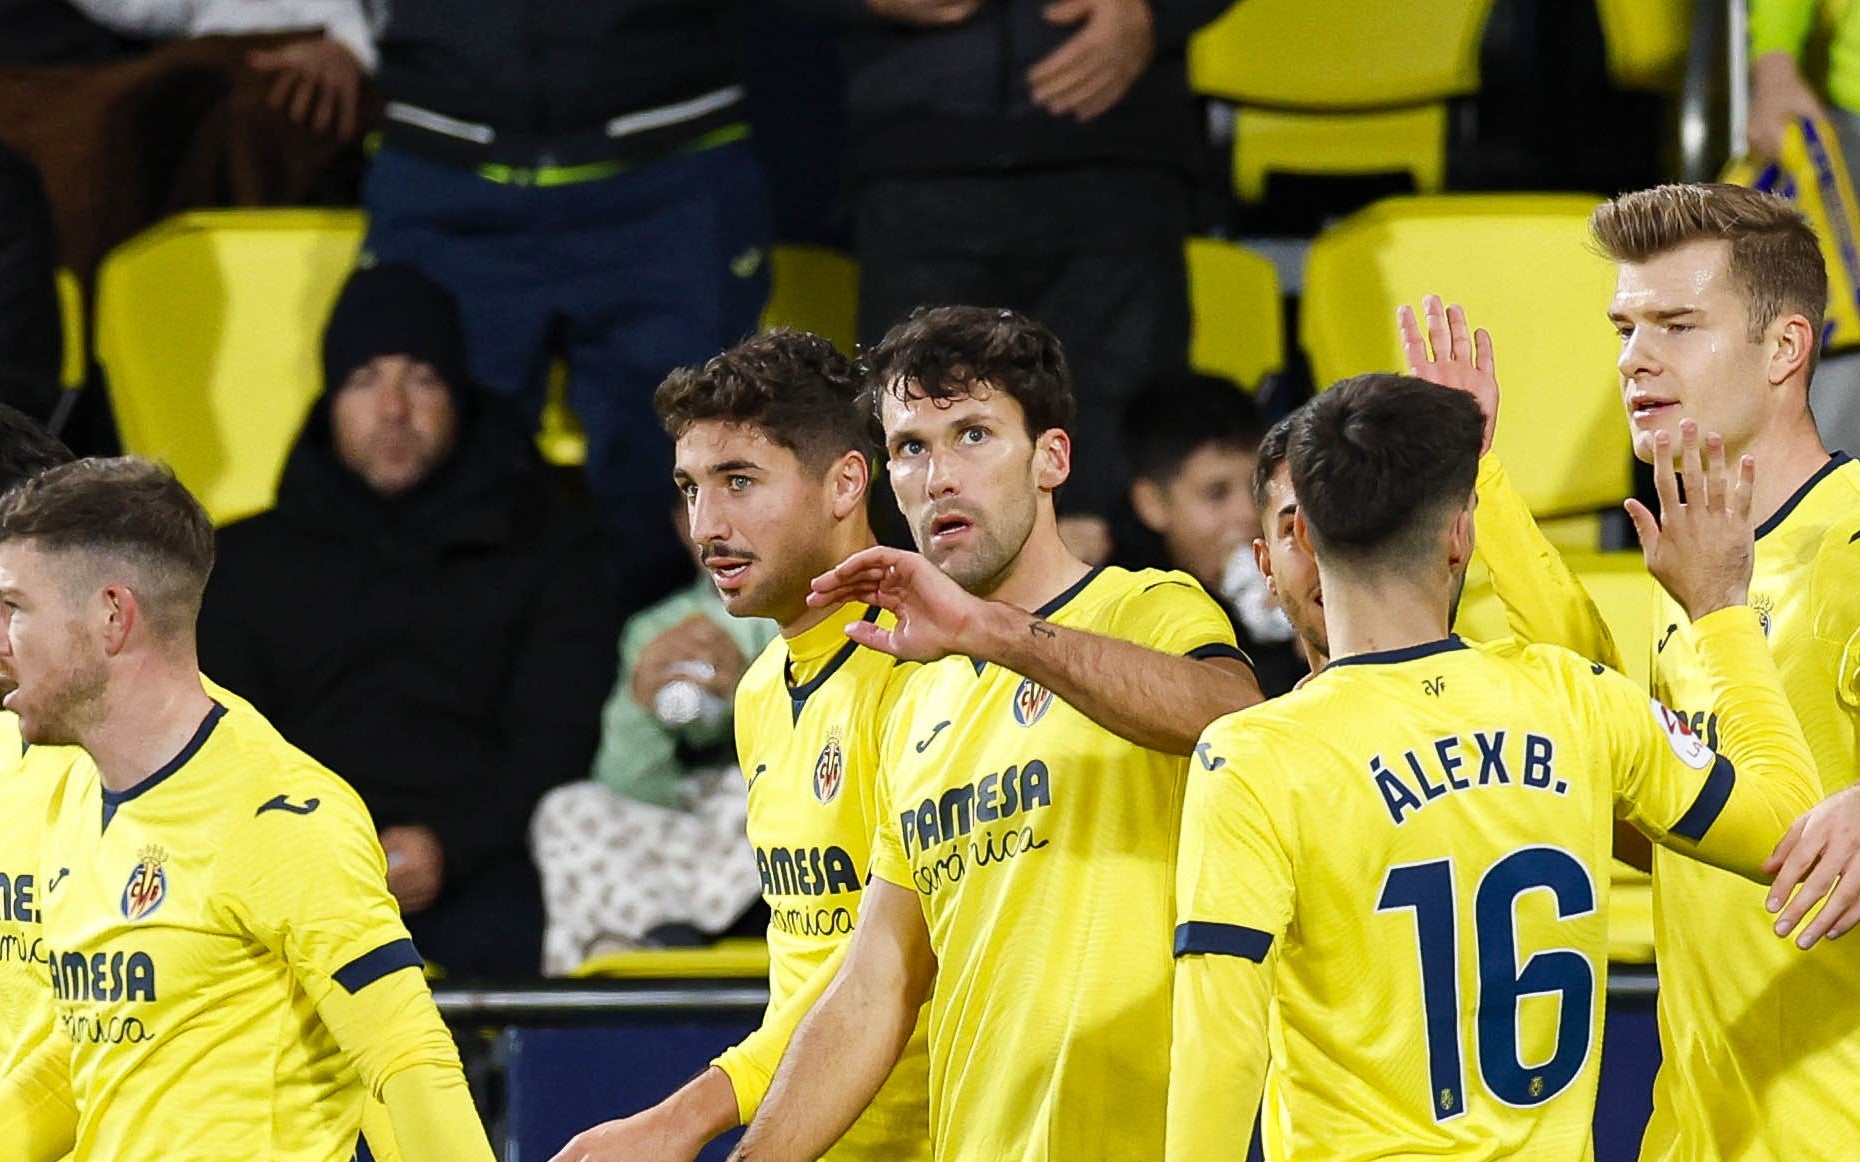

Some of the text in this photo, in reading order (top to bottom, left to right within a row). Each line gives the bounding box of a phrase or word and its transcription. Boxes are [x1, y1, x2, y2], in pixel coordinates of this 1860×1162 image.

[900, 759, 1051, 860] PAMESA
[1369, 730, 1568, 826] ÁLEX B.
[1375, 846, 1597, 1124] 16
